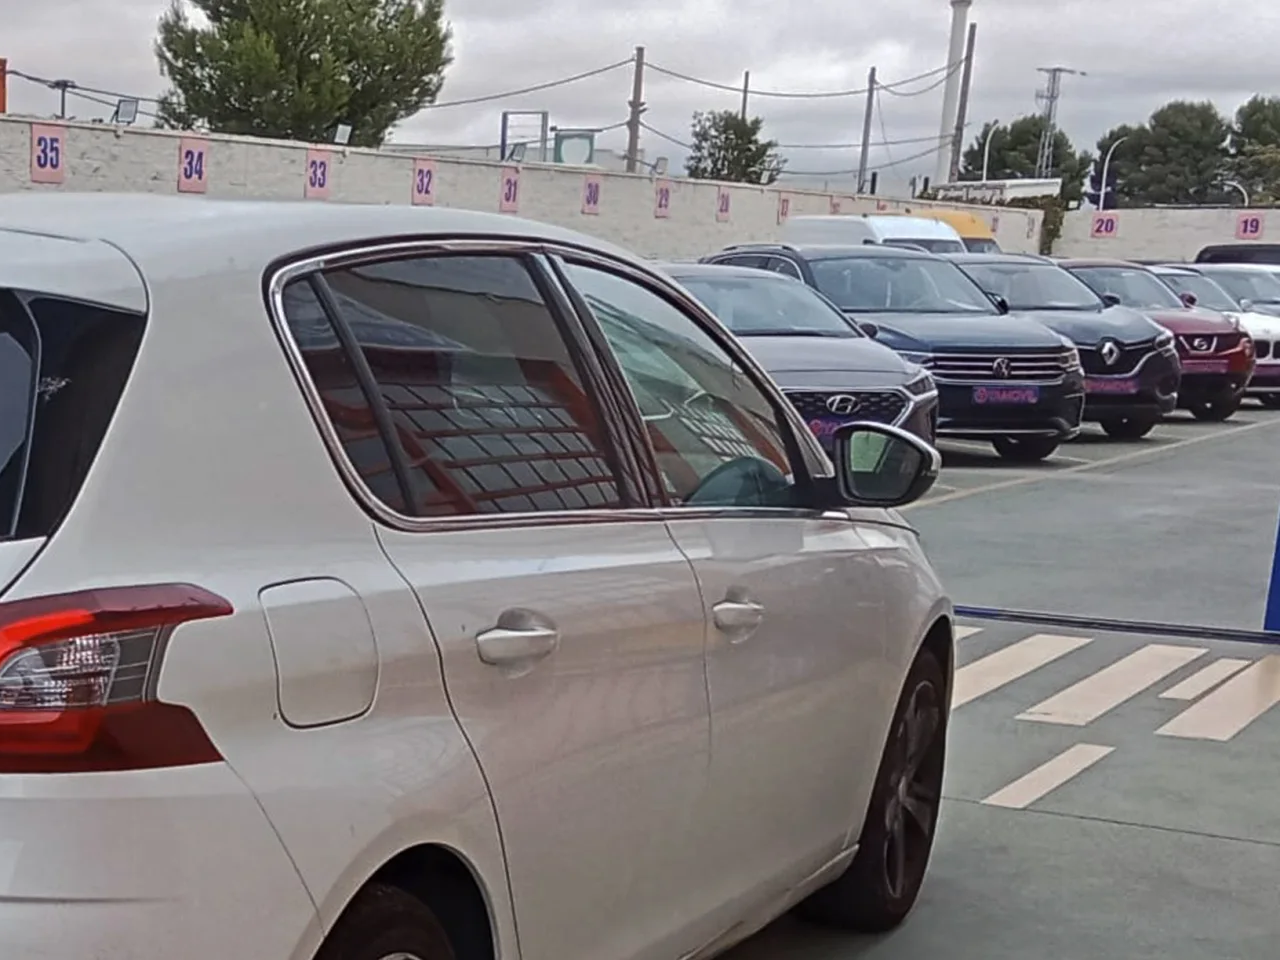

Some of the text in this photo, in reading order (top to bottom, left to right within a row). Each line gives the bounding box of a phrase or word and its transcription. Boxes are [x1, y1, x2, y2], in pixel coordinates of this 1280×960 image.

[36, 136, 60, 170] 35
[183, 151, 204, 181] 34
[309, 160, 326, 188] 33
[416, 169, 432, 195] 32
[504, 178, 518, 203] 31
[1095, 218, 1115, 233] 20
[1242, 218, 1260, 234] 19
